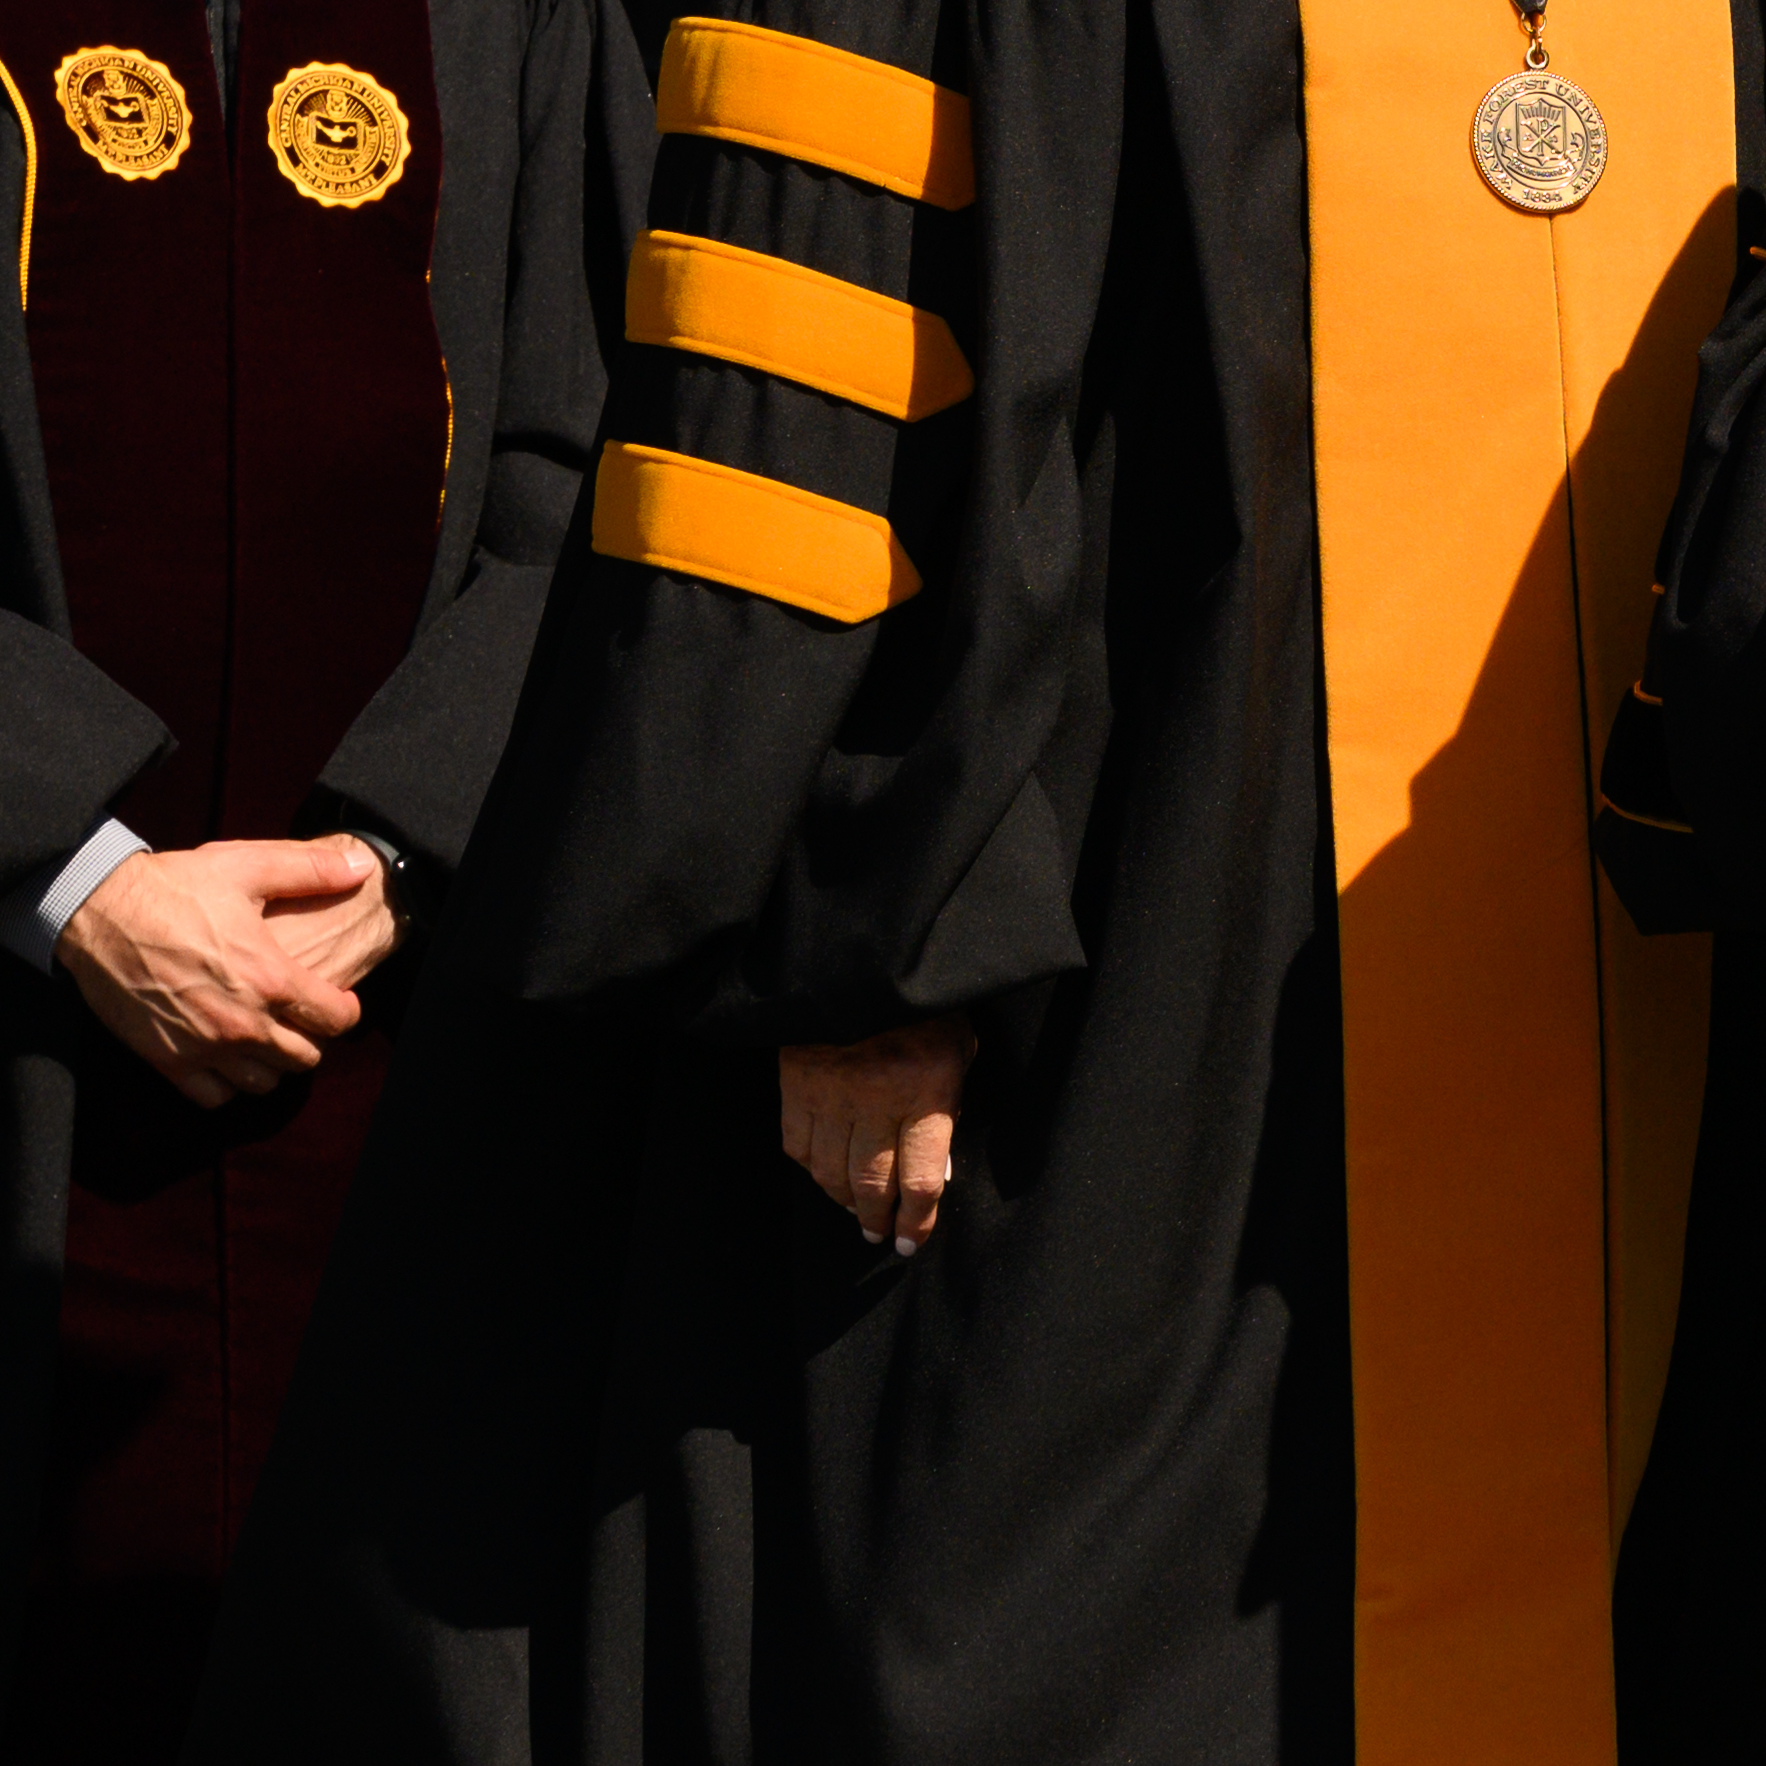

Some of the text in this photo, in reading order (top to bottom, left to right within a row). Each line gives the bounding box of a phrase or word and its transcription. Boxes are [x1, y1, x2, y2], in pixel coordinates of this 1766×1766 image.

[280, 88, 300, 148] CENTRAL
[298, 75, 363, 95] MICHIGAN
[365, 89, 397, 166] UNIVERSITY
[1480, 79, 1601, 193] WAKE FOREST UNIVERSITY
[314, 173, 378, 194] PLEASANT
